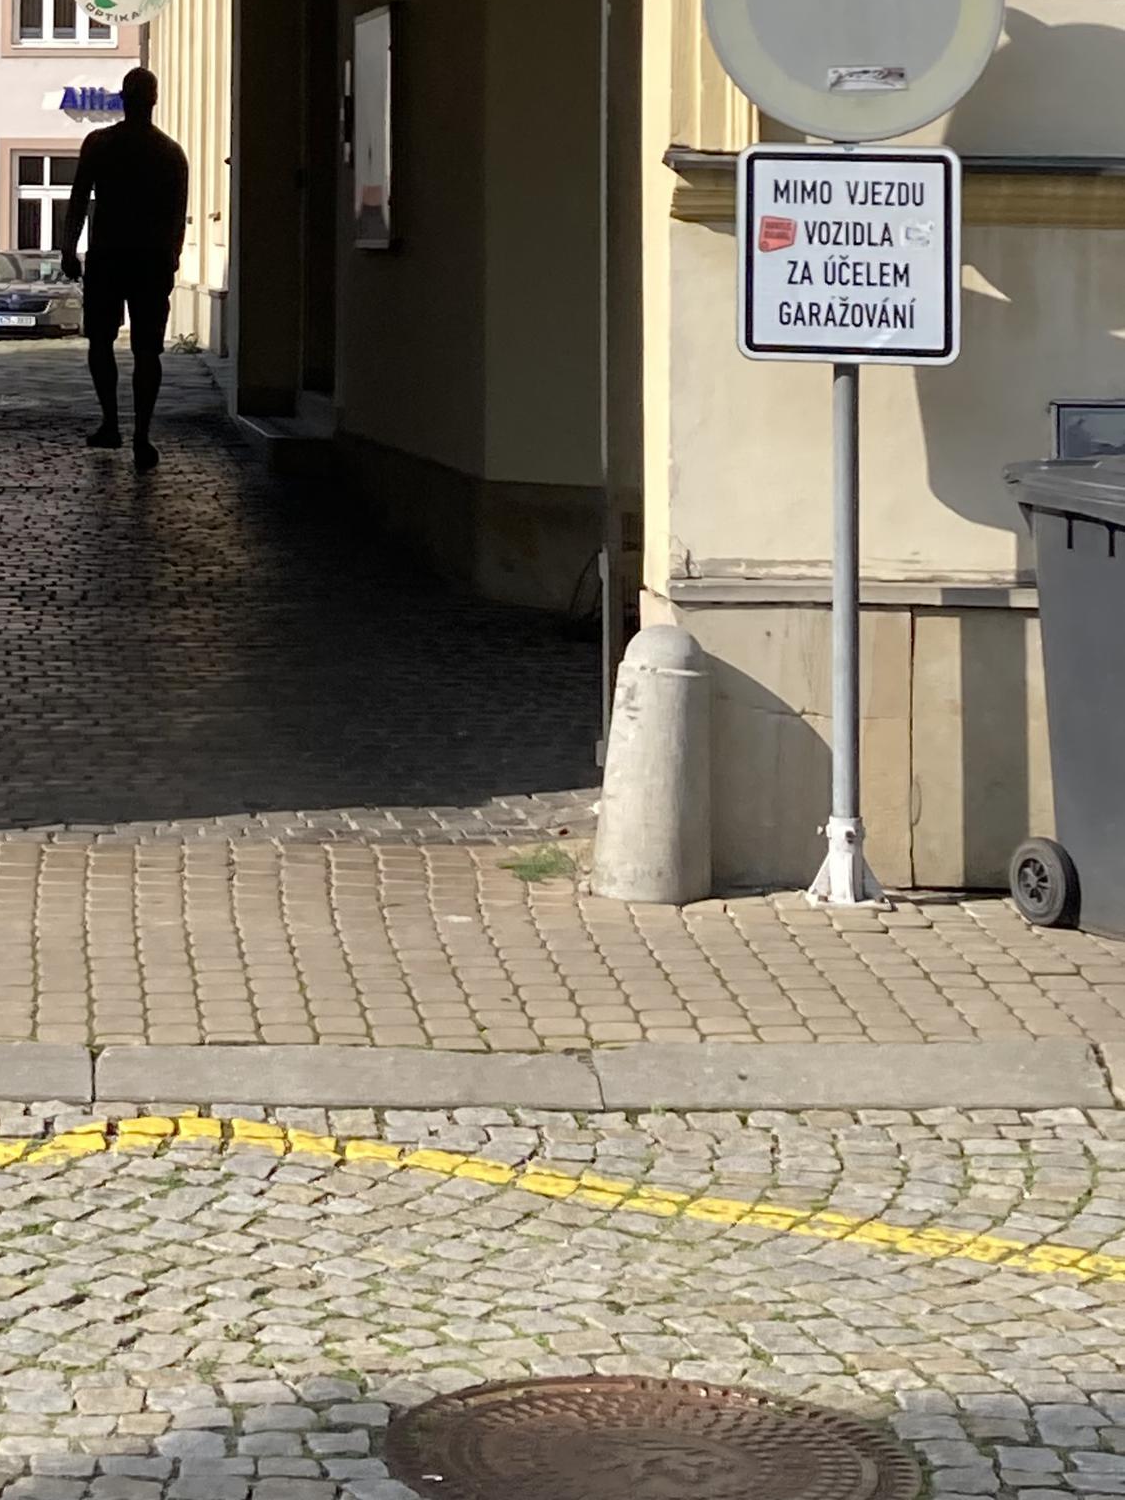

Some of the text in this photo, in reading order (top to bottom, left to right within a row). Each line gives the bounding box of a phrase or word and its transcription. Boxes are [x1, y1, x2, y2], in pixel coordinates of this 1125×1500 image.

[85, 2, 141, 22] OPTIKA
[773, 179, 925, 206] MIMO VJEZDU
[803, 220, 894, 247] VOZIDLA
[787, 255, 910, 288] ZA ÚČELEM
